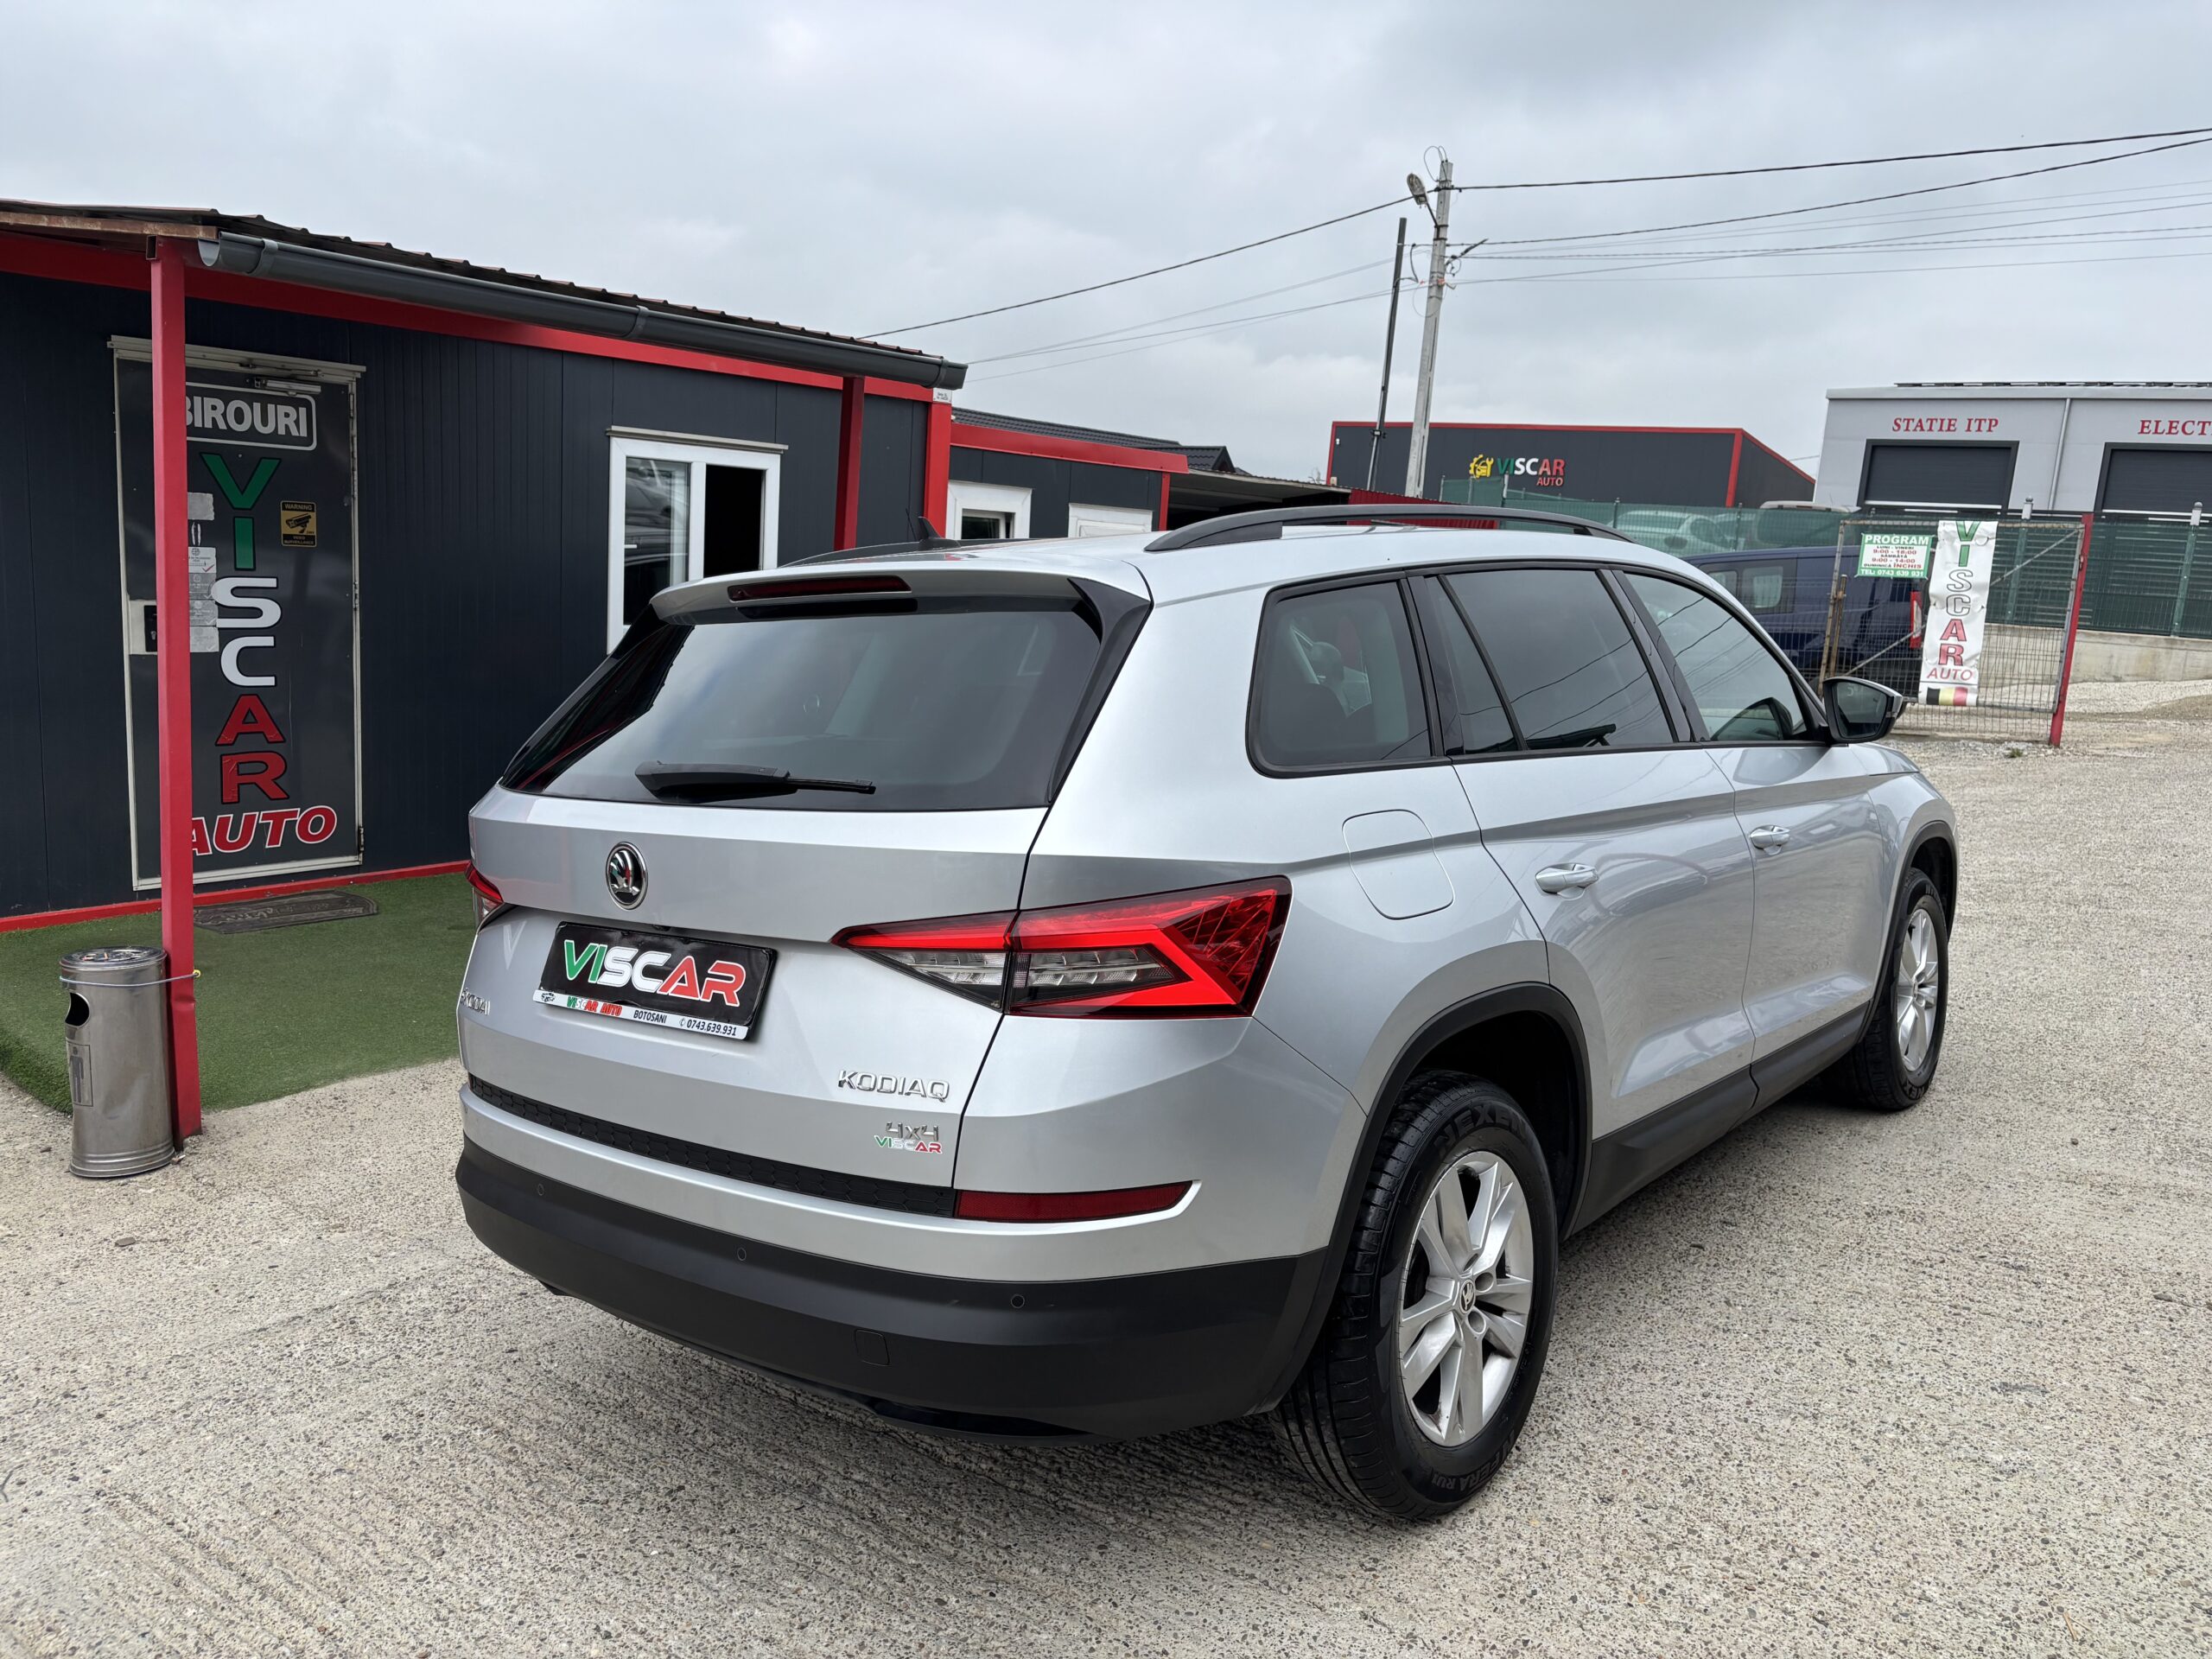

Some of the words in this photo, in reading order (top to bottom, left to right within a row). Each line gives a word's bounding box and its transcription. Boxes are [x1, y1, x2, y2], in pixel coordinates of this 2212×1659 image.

[1892, 417, 1957, 432] STATIE
[1965, 417, 1999, 432] ITP
[2138, 419, 2212, 435] ELECT
[1497, 457, 1565, 475] VISCAR
[1536, 477, 1563, 486] AUTO
[1865, 535, 1929, 545] PROGRAM
[1938, 520, 1981, 666] VISCAR
[1927, 668, 1974, 681] AUTO
[192, 805, 338, 856] AUTO
[563, 939, 747, 1007] VISCAR
[567, 995, 599, 1012] VISCAR
[600, 1002, 623, 1016] AUTO
[633, 1009, 668, 1024] BOTOSANI
[687, 1020, 737, 1036] 0743.639.931
[838, 1070, 950, 1103] KODIAQ
[874, 1135, 943, 1154] VISCAR
